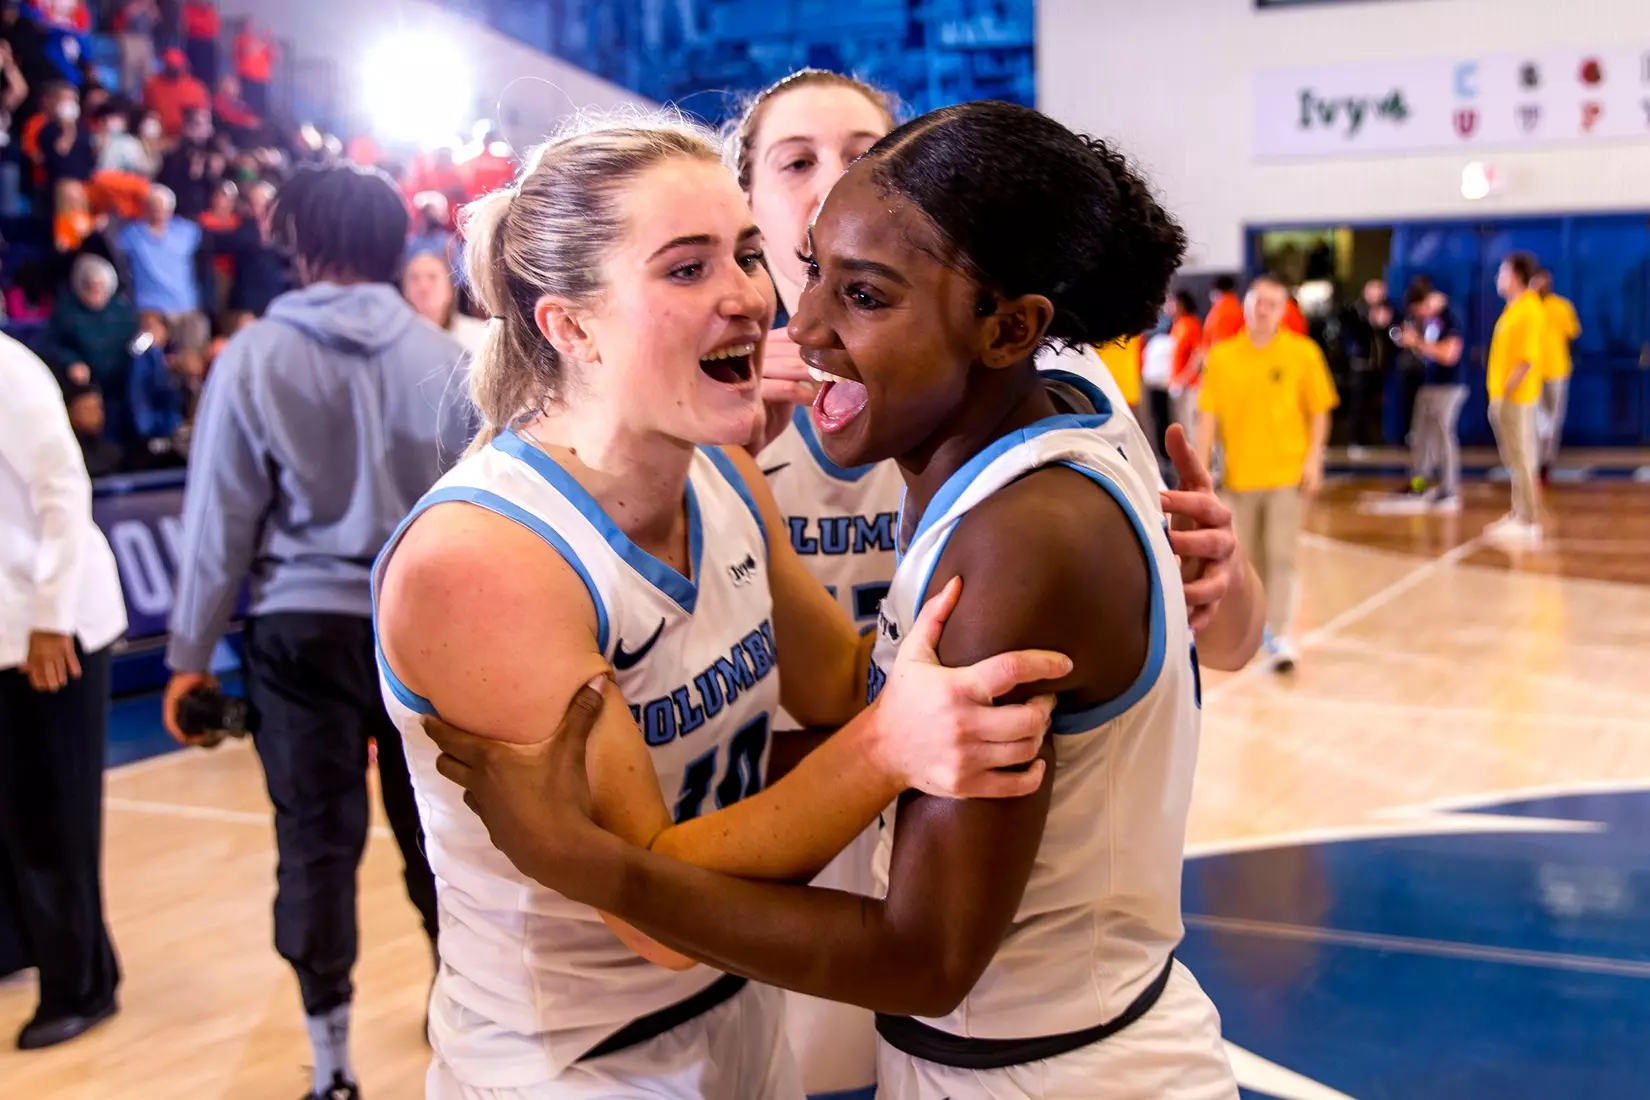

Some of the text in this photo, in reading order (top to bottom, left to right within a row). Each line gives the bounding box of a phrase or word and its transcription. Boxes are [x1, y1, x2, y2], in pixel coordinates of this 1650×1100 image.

[1298, 88, 1366, 139] Ivy
[781, 511, 898, 555] LUM
[673, 711, 770, 825] 10
